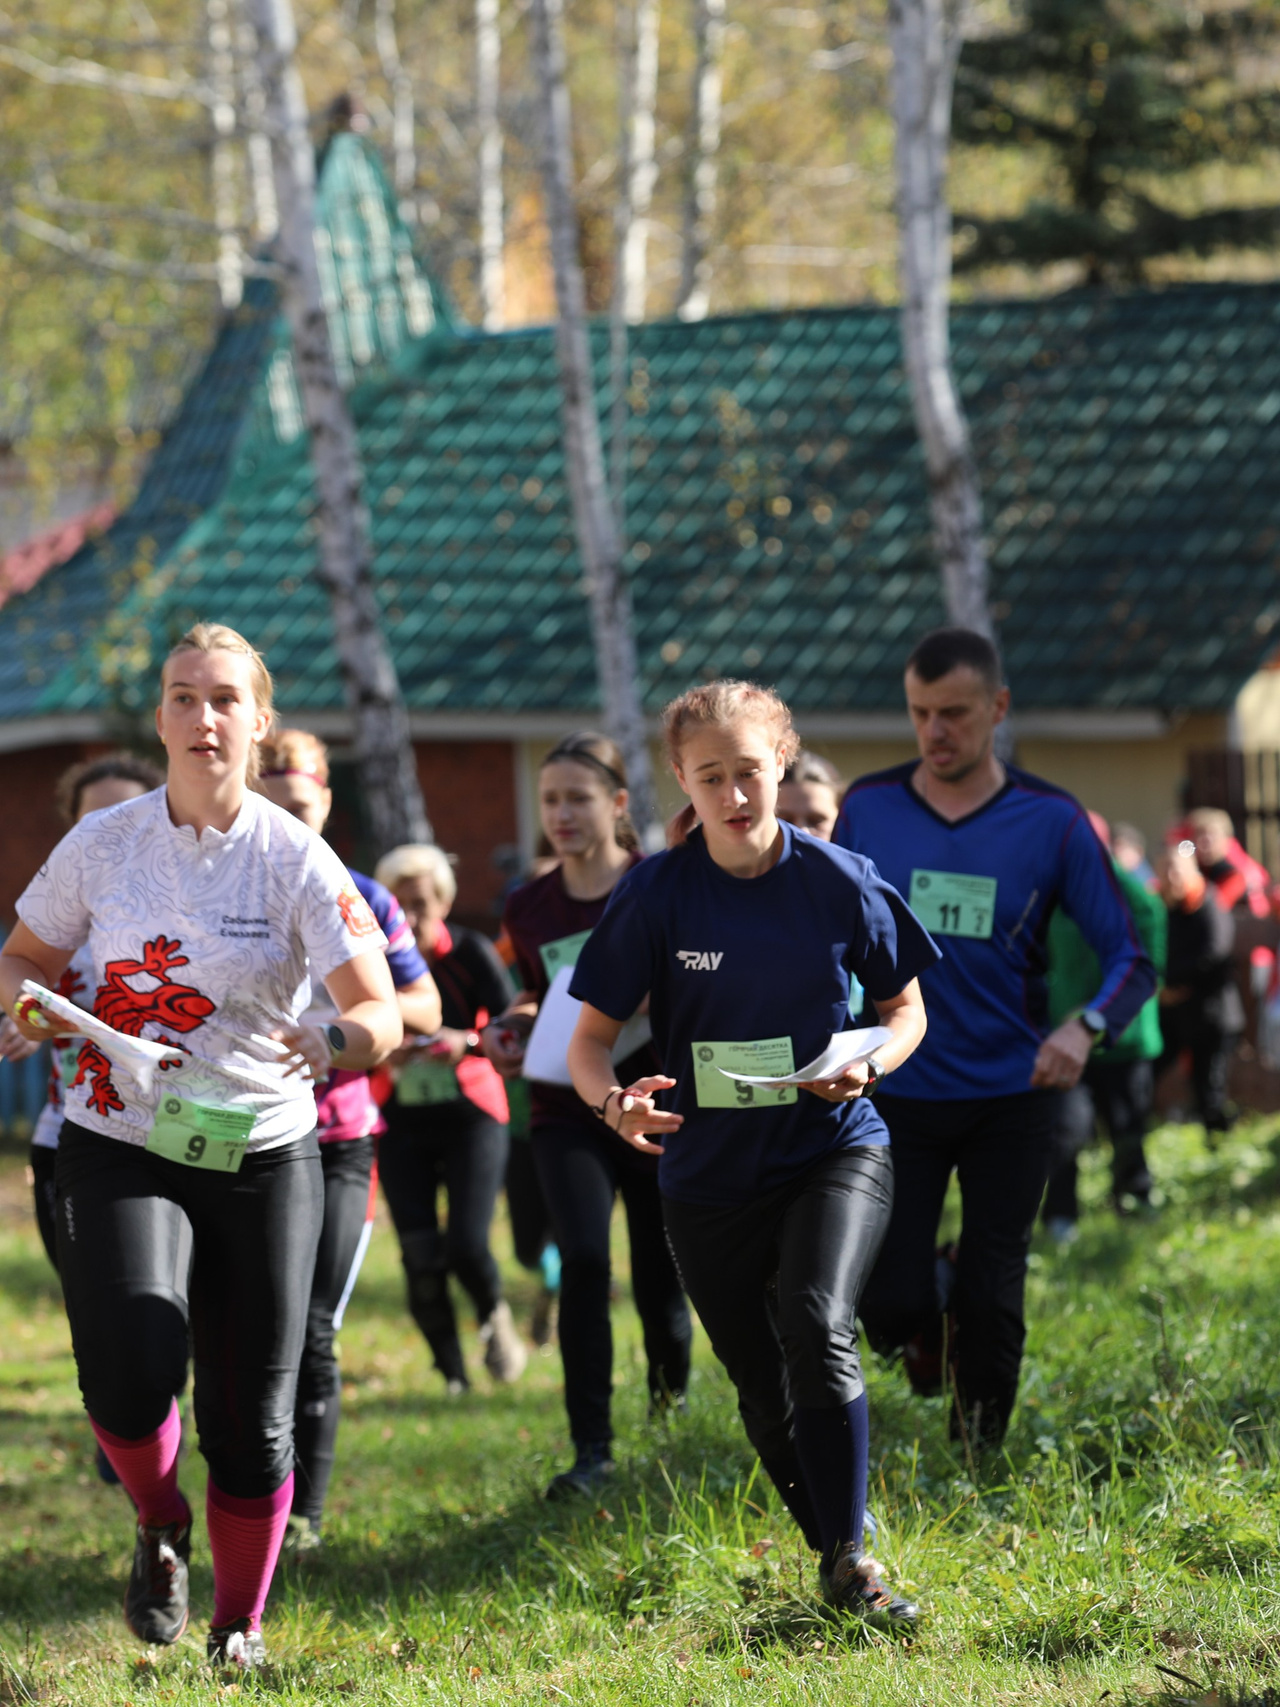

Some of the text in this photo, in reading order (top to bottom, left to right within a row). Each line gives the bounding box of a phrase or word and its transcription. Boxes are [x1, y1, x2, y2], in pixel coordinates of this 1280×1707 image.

[939, 903, 961, 931] 11
[676, 950, 723, 971] RAY
[184, 1134, 236, 1168] 9 1
